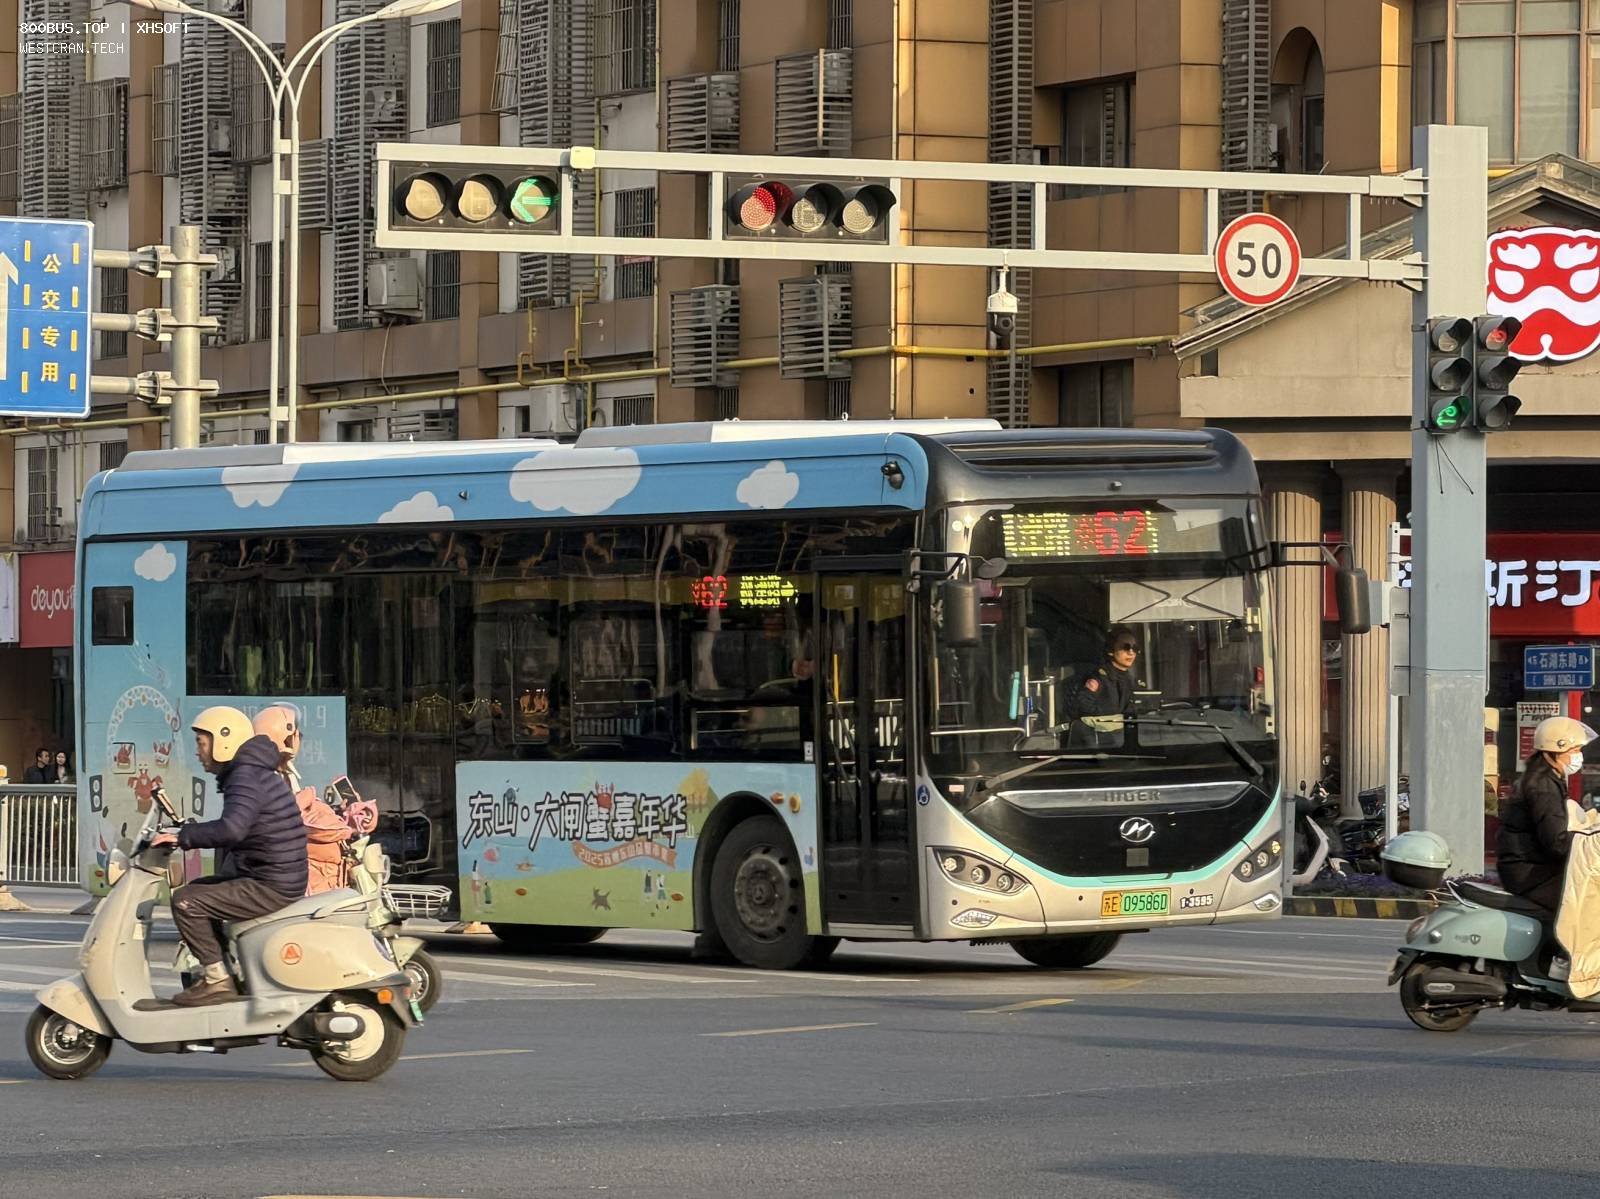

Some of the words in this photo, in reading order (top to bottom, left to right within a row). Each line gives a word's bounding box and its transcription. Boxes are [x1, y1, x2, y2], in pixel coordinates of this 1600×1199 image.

[1237, 242, 1282, 278] 50
[40, 253, 62, 383] 公交专用
